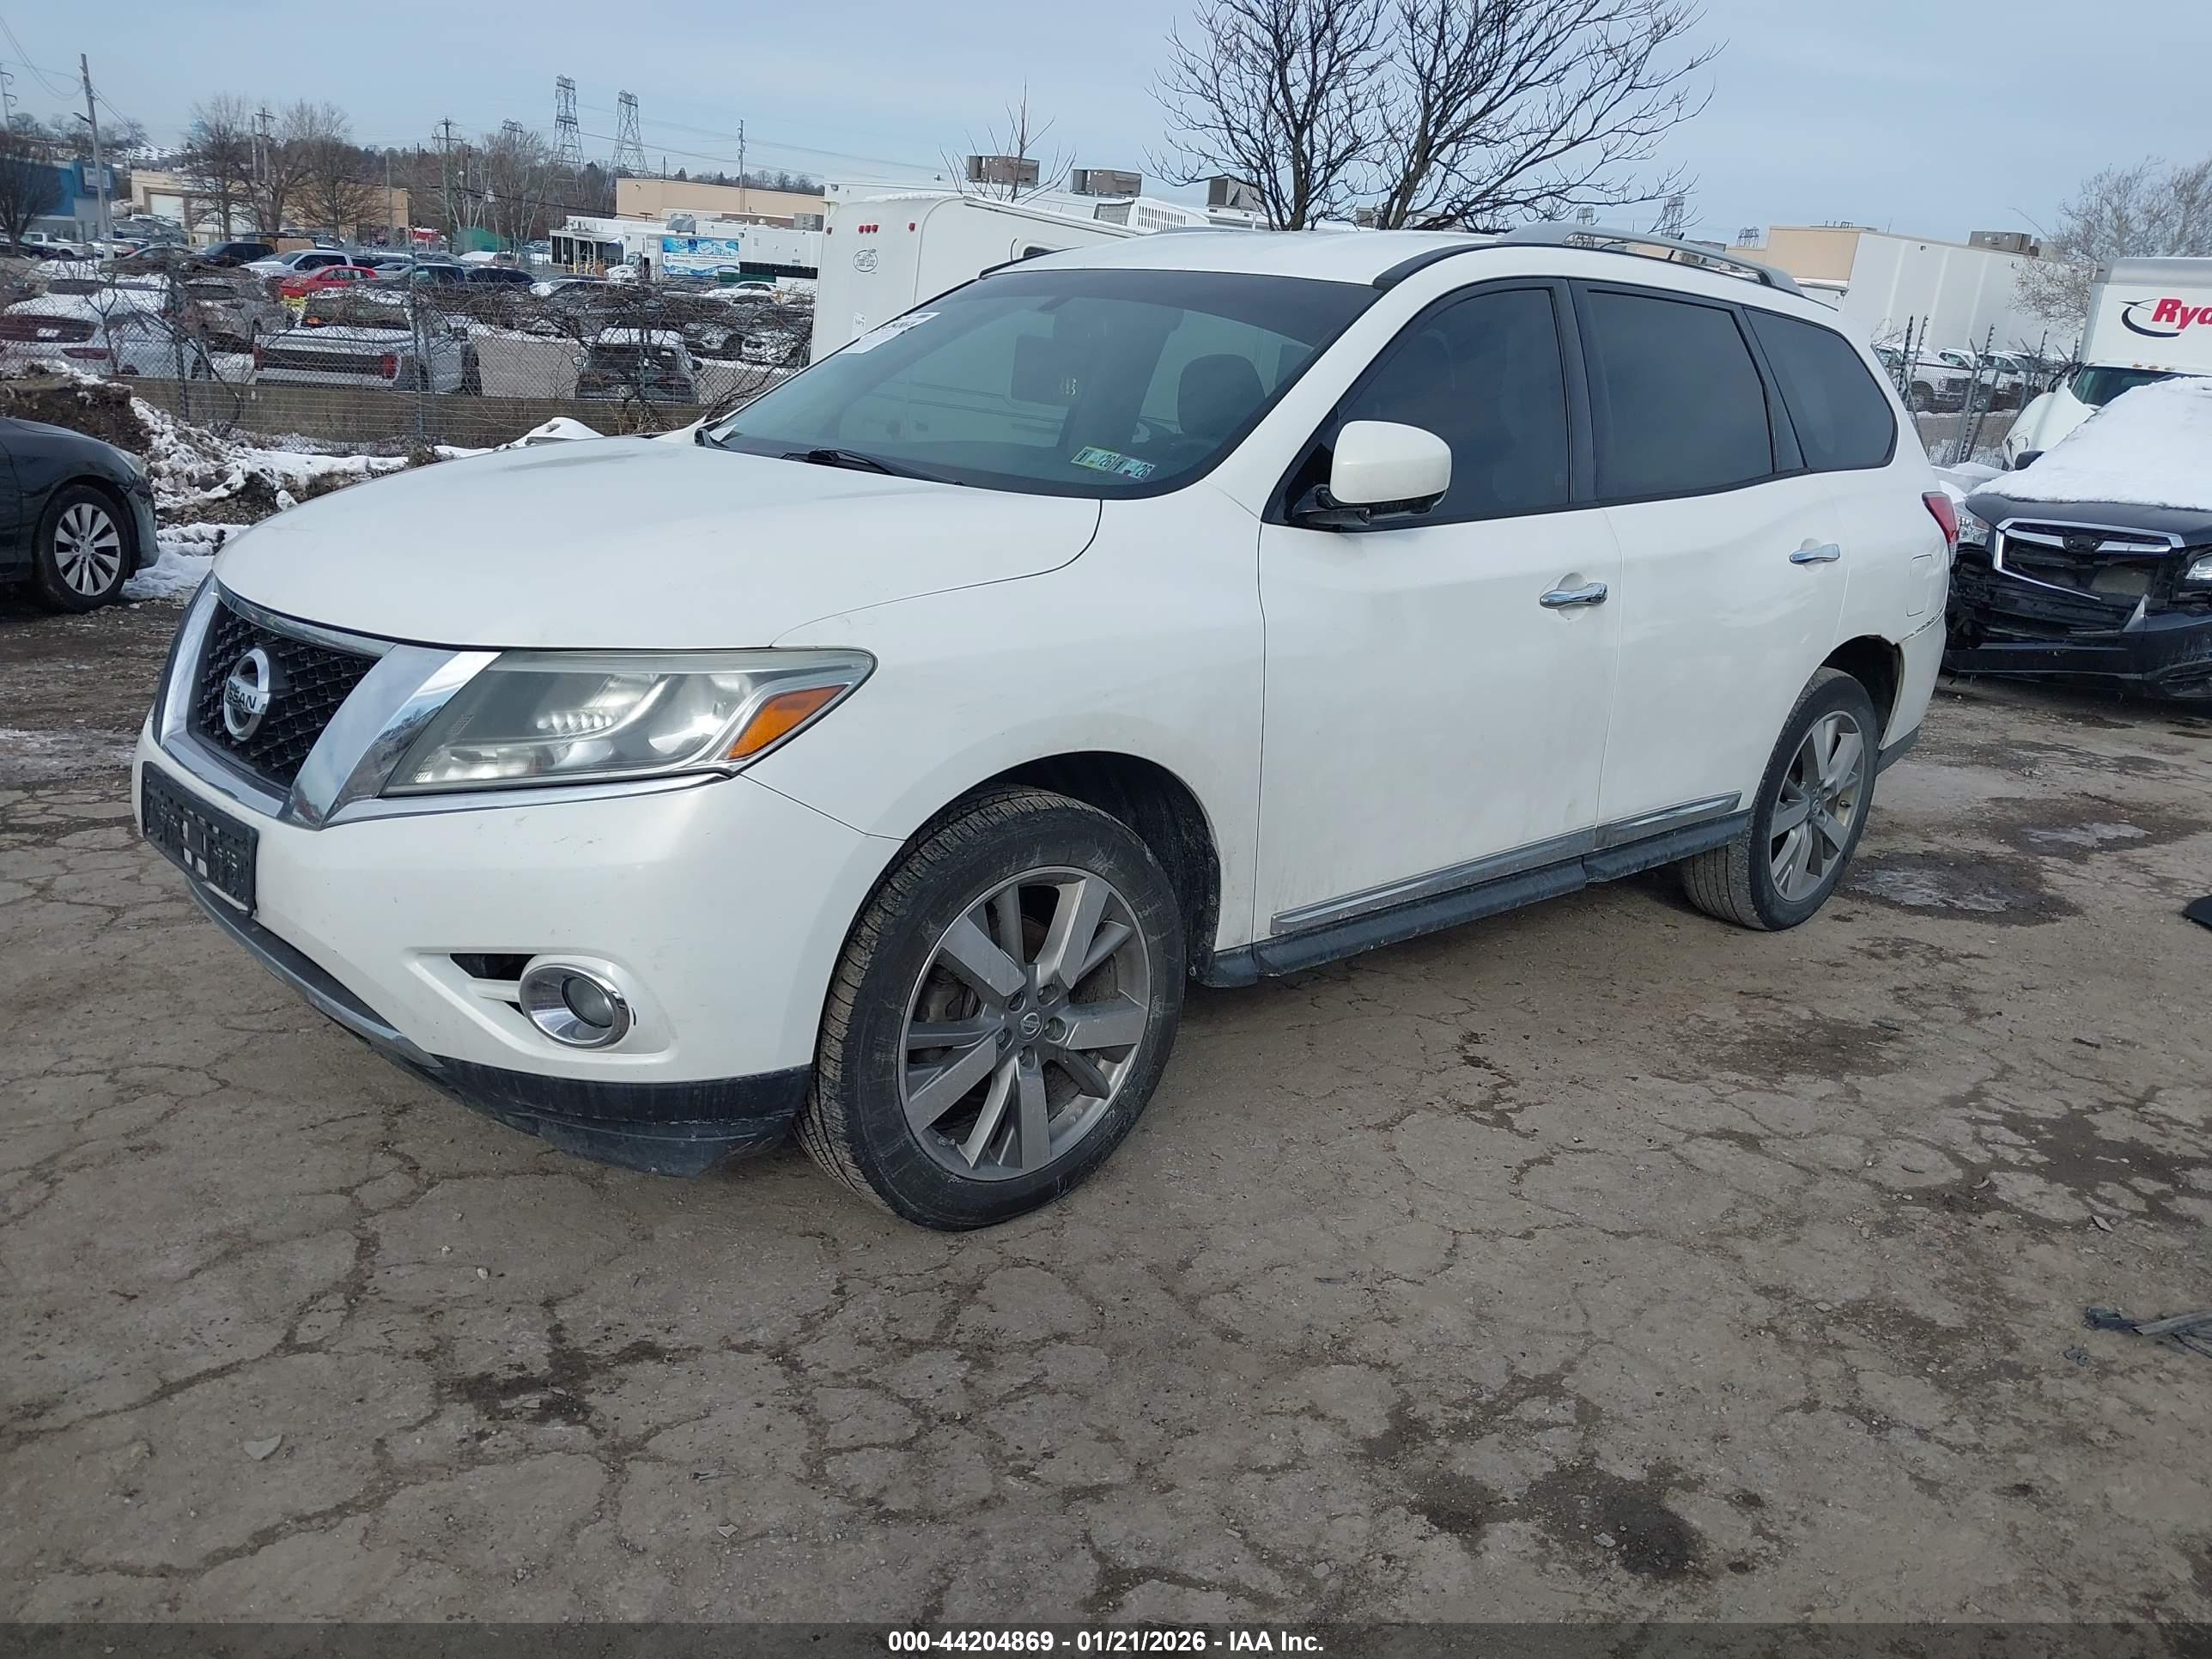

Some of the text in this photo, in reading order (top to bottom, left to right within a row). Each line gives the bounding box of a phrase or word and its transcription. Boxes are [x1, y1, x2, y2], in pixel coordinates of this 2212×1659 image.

[1098, 454, 1116, 468] 26
[1135, 464, 1152, 477] 26
[226, 688, 257, 709] SSAN
